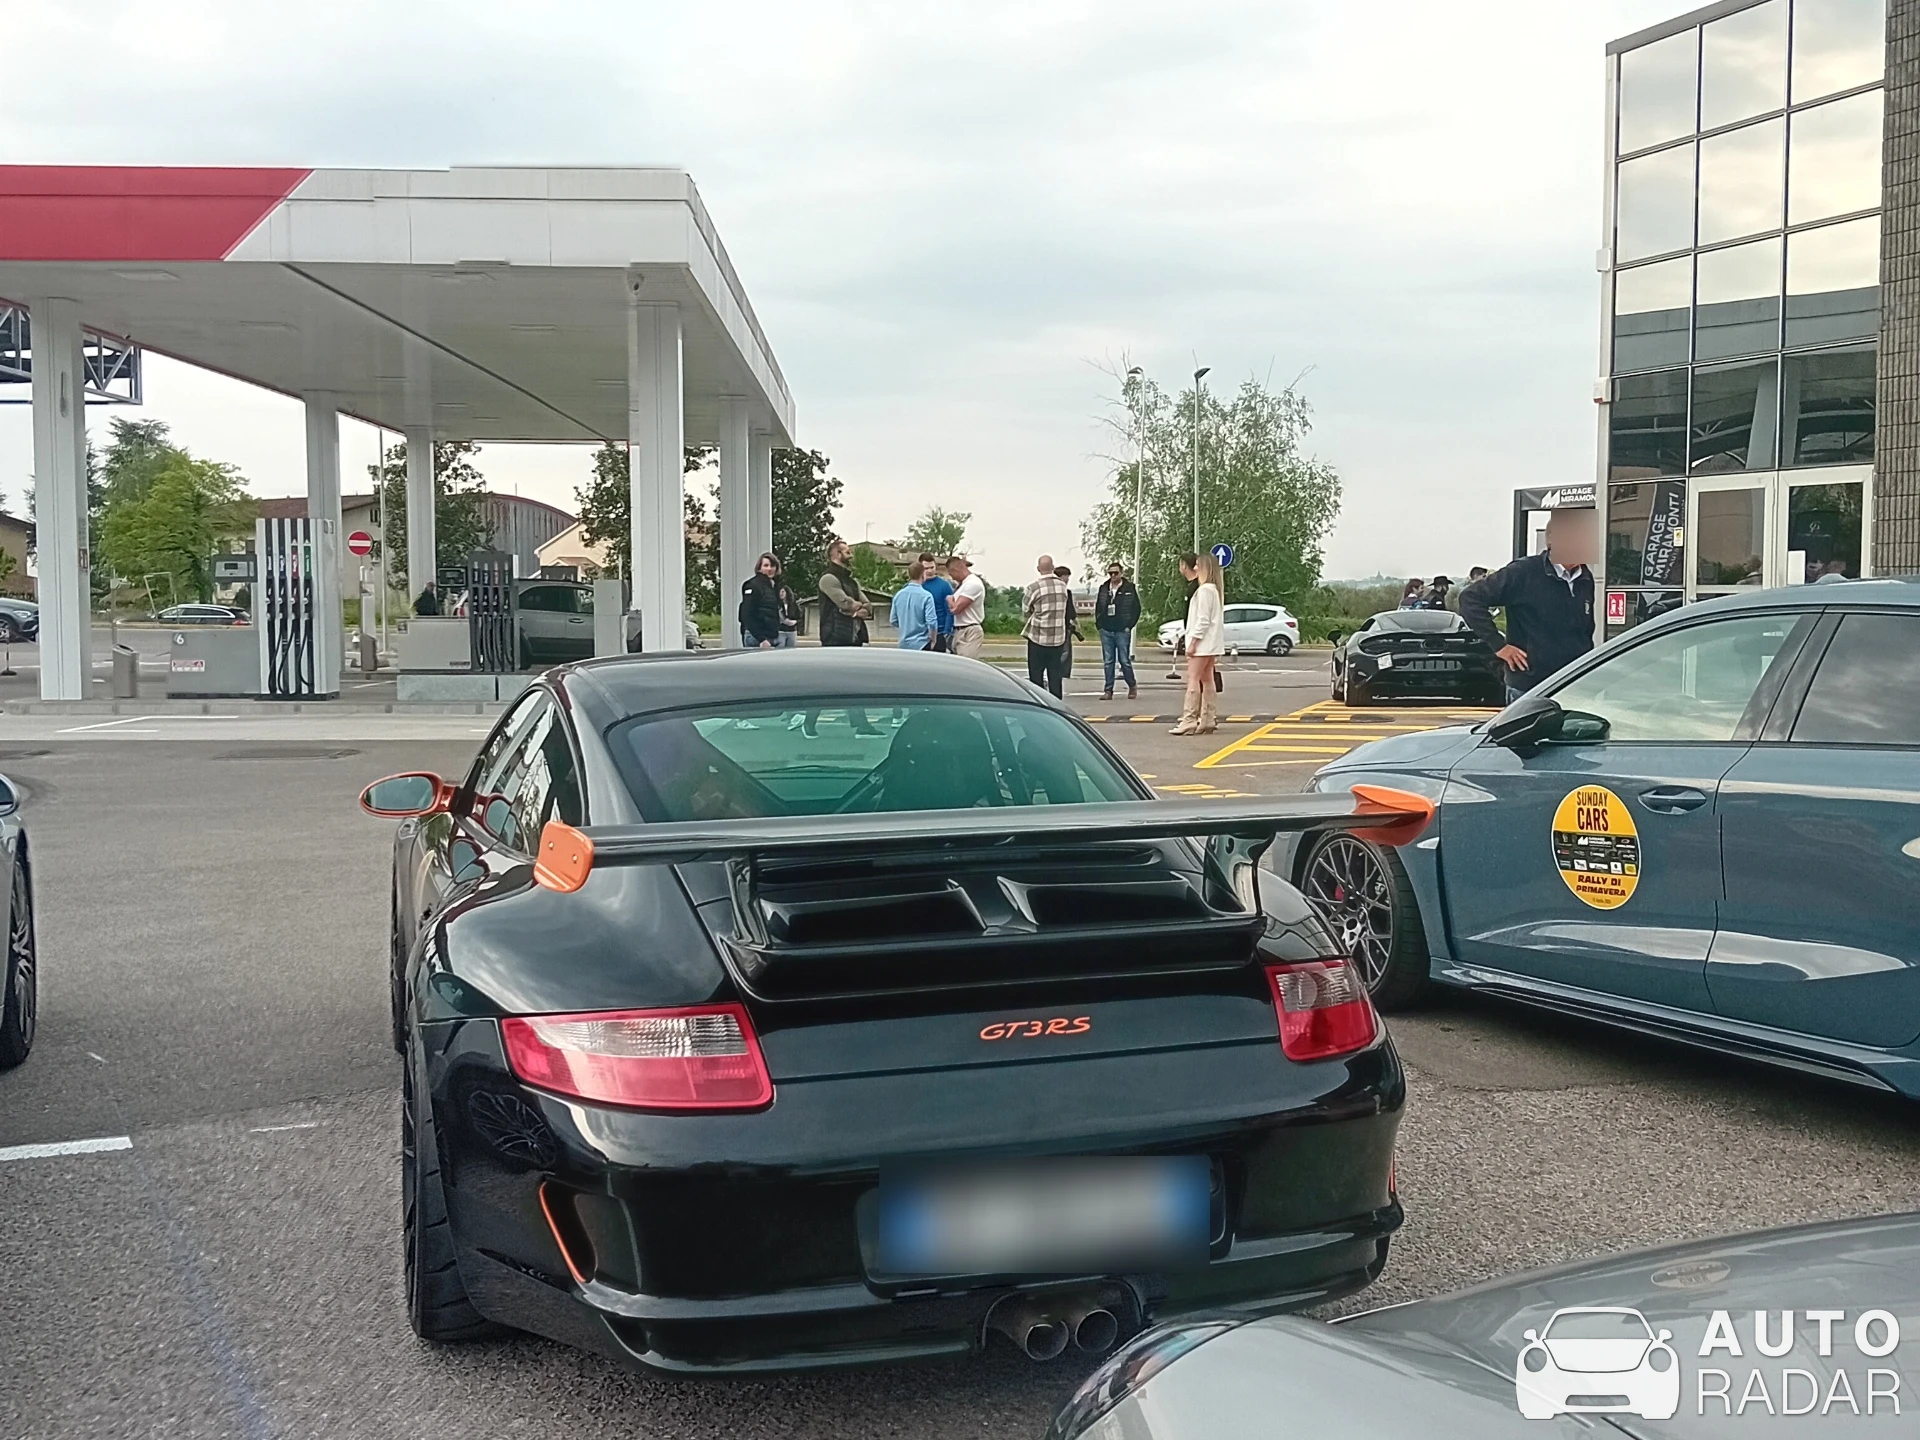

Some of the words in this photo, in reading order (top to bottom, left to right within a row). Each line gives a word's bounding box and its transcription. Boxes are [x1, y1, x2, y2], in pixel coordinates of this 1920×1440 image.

[1561, 487, 1593, 496] GARAGE
[1561, 494, 1597, 503] MIRAMON
[1653, 492, 1679, 579] MIRAMONTI
[1644, 514, 1667, 577] GARAGE
[176, 633, 185, 645] 6
[1576, 791, 1608, 807] SUNDAY
[1577, 807, 1609, 832] CARS
[1577, 874, 1608, 886] RALLY
[1611, 878, 1622, 887] DI
[1576, 885, 1627, 897] PRIMAVERA
